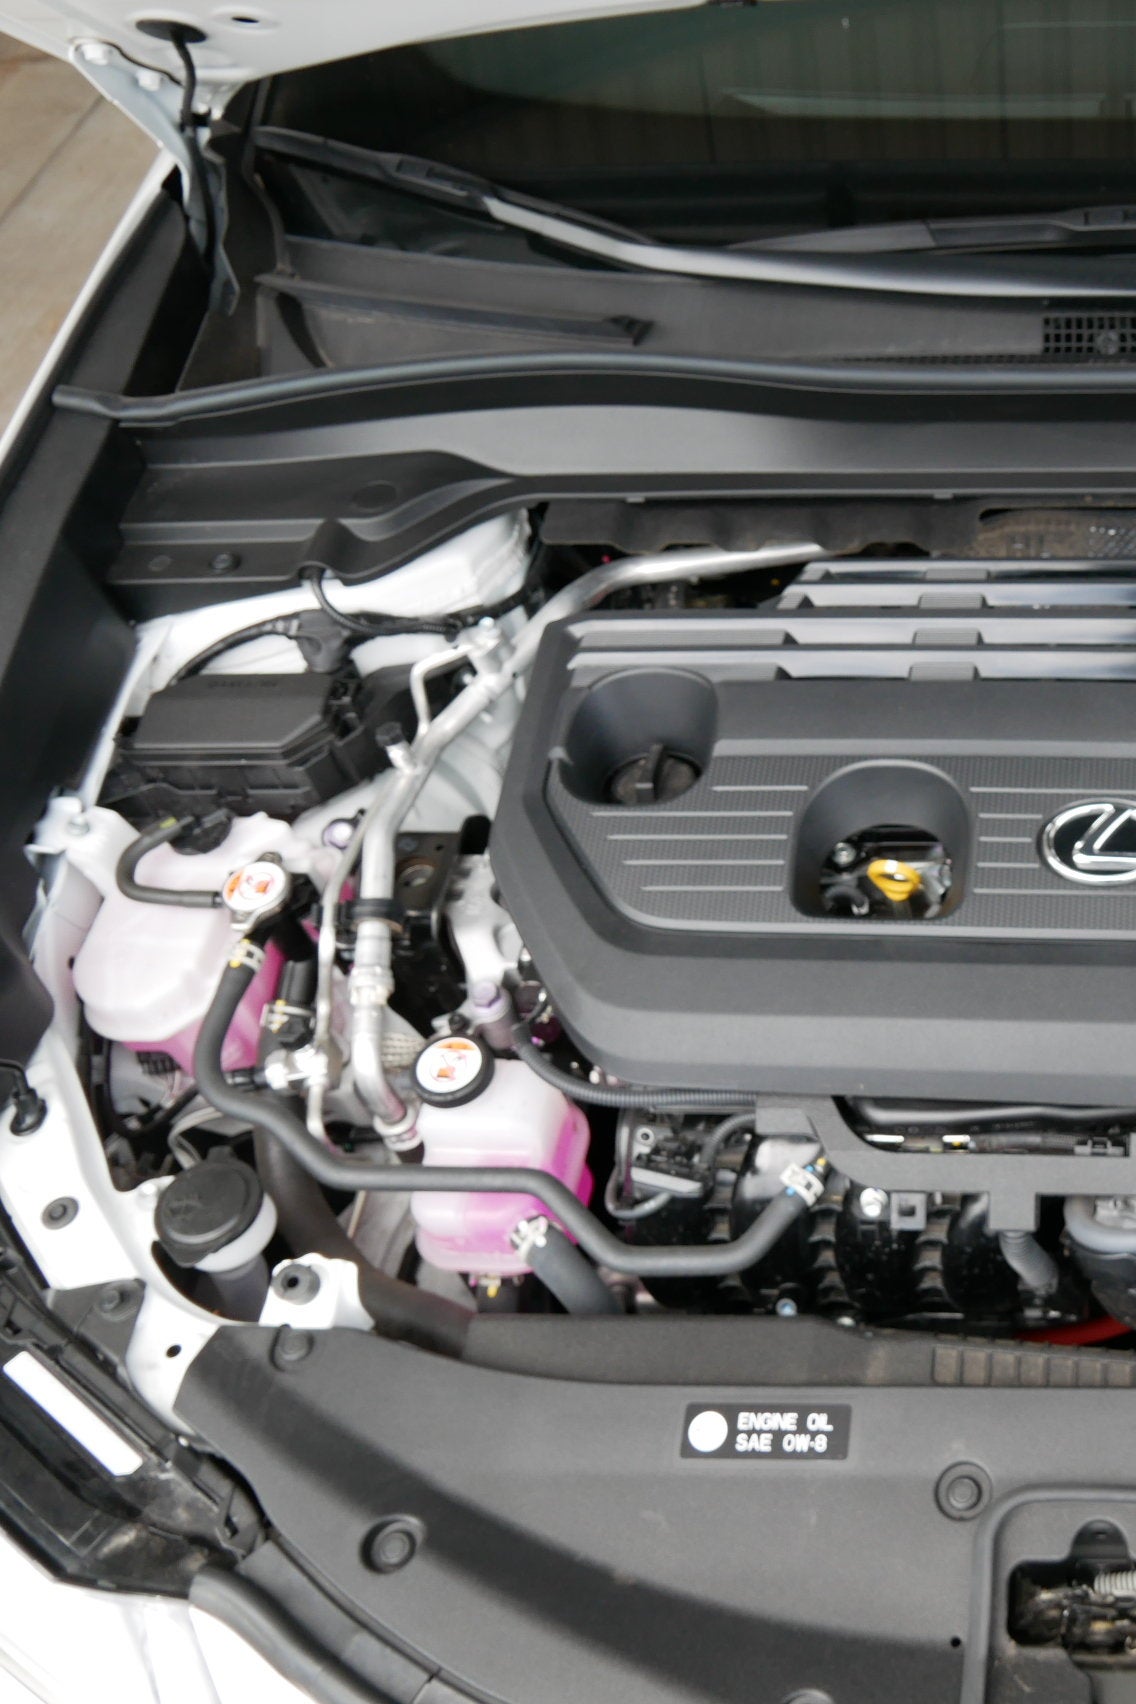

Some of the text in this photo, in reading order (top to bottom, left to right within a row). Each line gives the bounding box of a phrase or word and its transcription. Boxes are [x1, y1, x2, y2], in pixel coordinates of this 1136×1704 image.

[737, 1412, 834, 1432] ENGINE OIL
[735, 1433, 773, 1452] SAE
